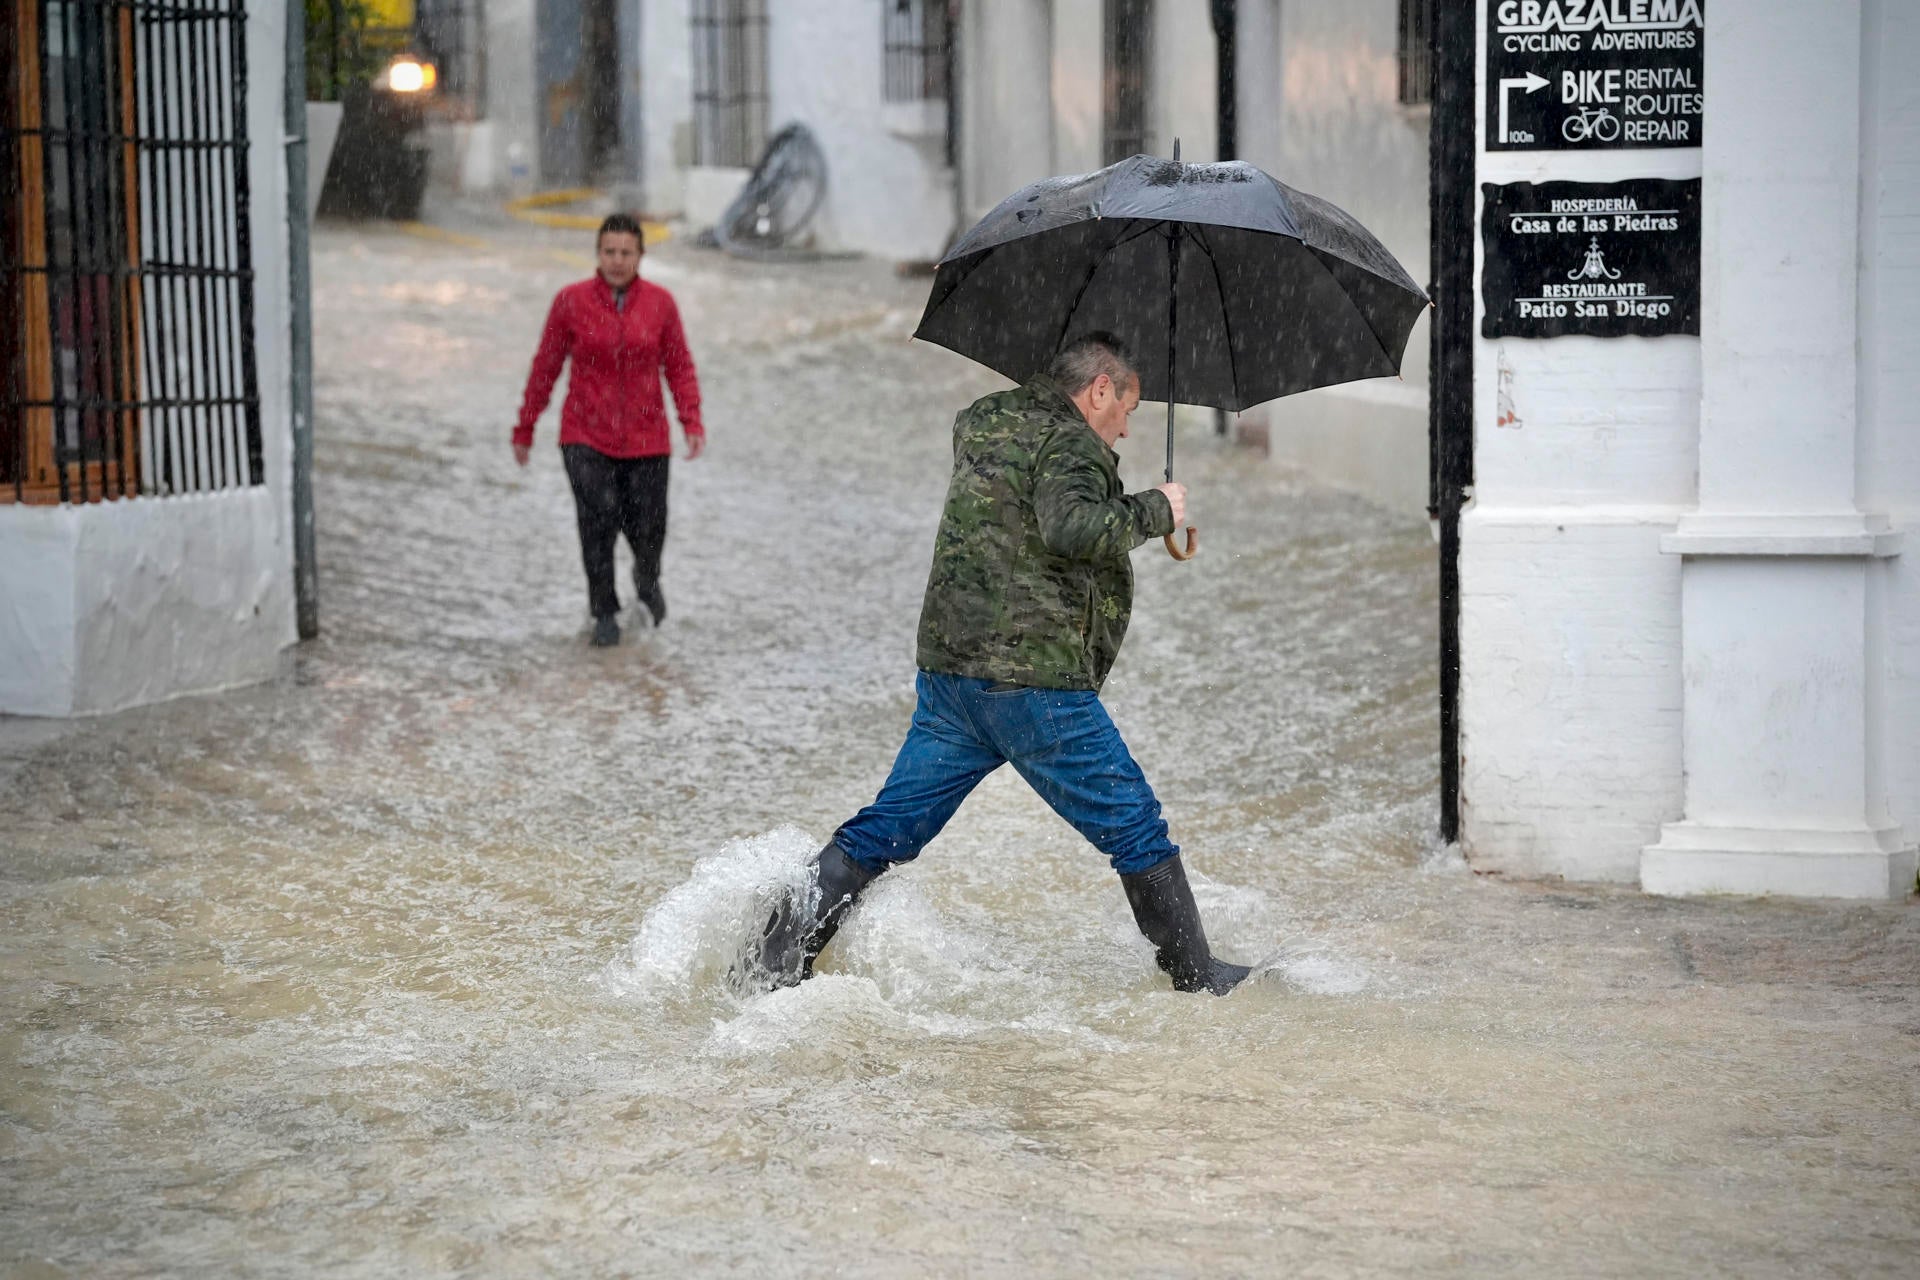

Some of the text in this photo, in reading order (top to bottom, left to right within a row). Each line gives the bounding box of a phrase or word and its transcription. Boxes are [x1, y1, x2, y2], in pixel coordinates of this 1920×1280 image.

[1497, 0, 1704, 31] GRAZALEMA
[1504, 31, 1696, 53] CYCLING ADVENTURES
[1562, 68, 1696, 104] BIKE RENTAL
[1625, 94, 1703, 115] ROUTES
[1509, 130, 1535, 143] 100m
[1625, 120, 1689, 141] REPAIR
[1551, 195, 1638, 212] HOSPEDERÍA
[1511, 215, 1678, 234] Casa de las Piedras
[1543, 283, 1646, 297] RESTAURANTE
[1519, 301, 1671, 319] Patio San Diego
